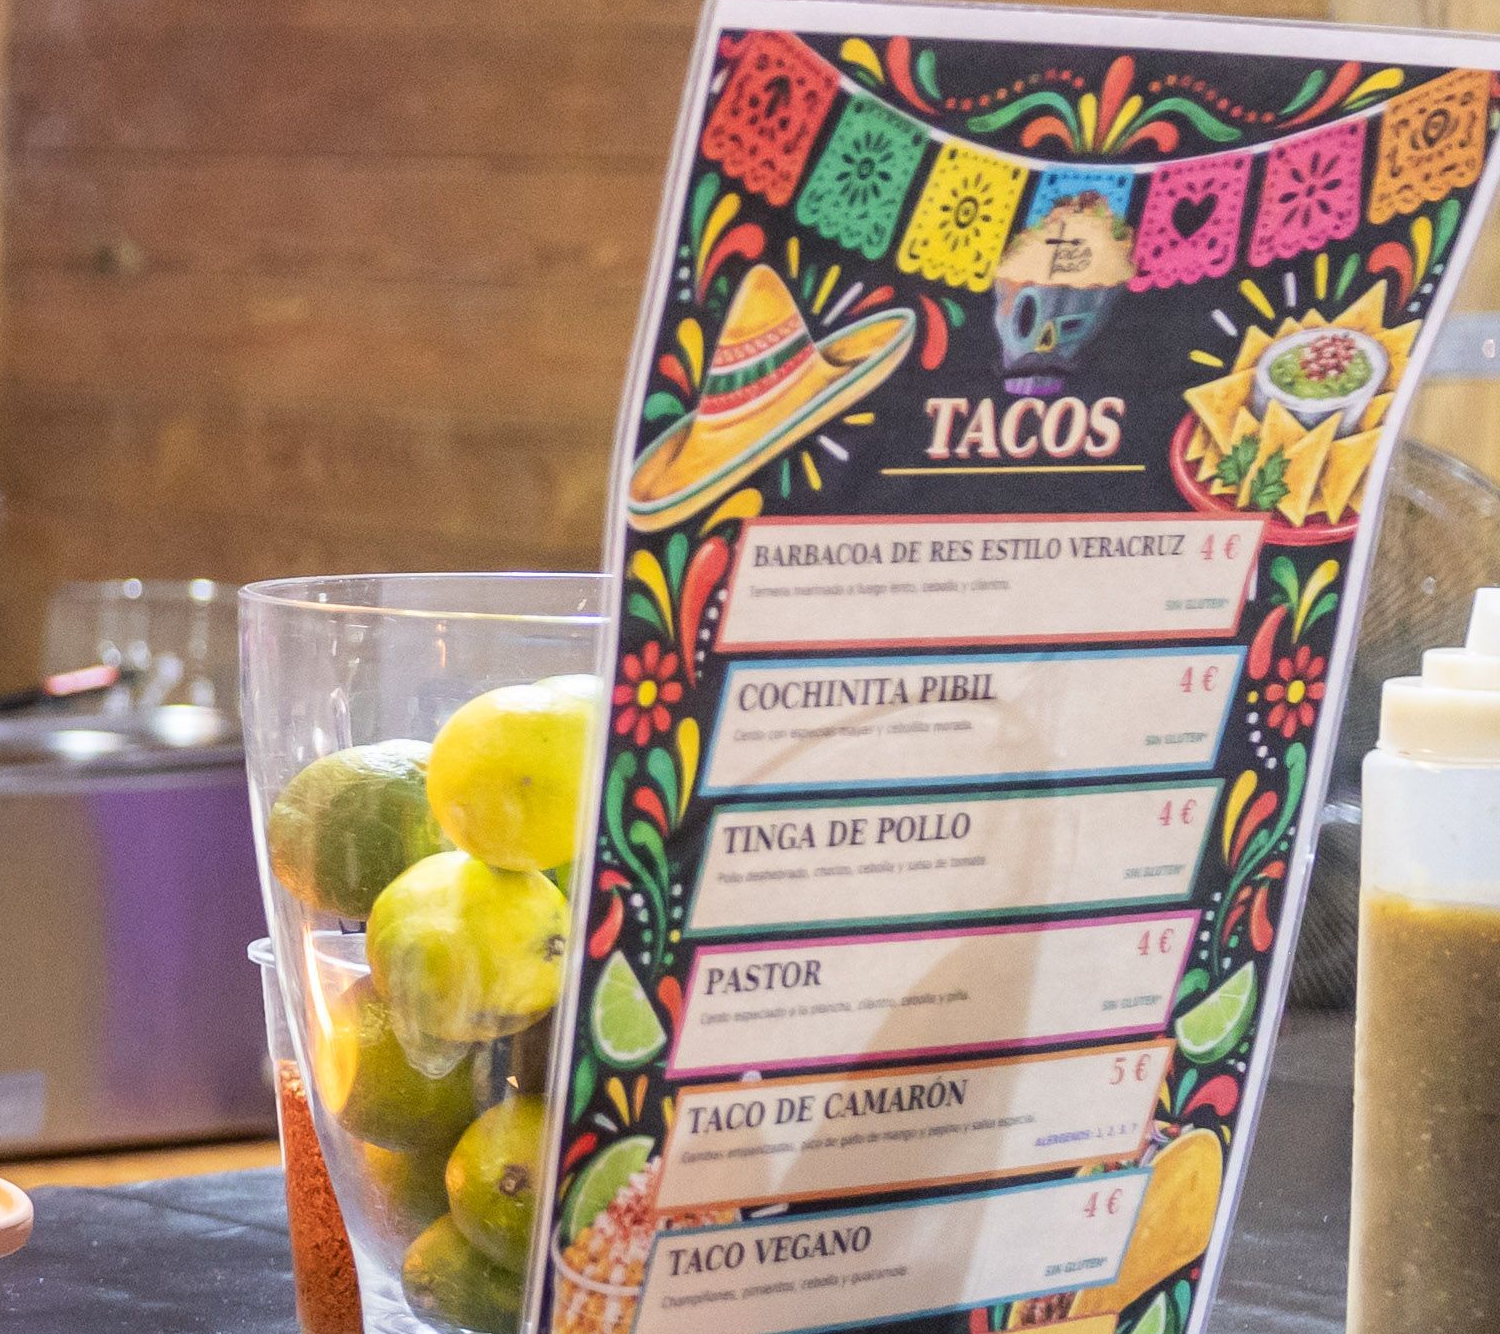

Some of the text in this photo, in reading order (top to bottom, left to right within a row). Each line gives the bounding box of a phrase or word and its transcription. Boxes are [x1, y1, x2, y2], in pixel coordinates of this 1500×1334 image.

[924, 396, 1127, 460] TACOS
[753, 534, 1241, 568] BARBACOA DE RES ESTILO VERACRUZ 4 €
[738, 666, 1219, 711] COCHINITA PIBIL 4 €
[723, 798, 1198, 854] TINGA DE POLLO 4 €
[704, 928, 1175, 995] PASTOR 4 €
[688, 1053, 1152, 1135] TACO DE CAMARÓN 5 €
[669, 1188, 1123, 1277] TACO VEGANO 4 €
